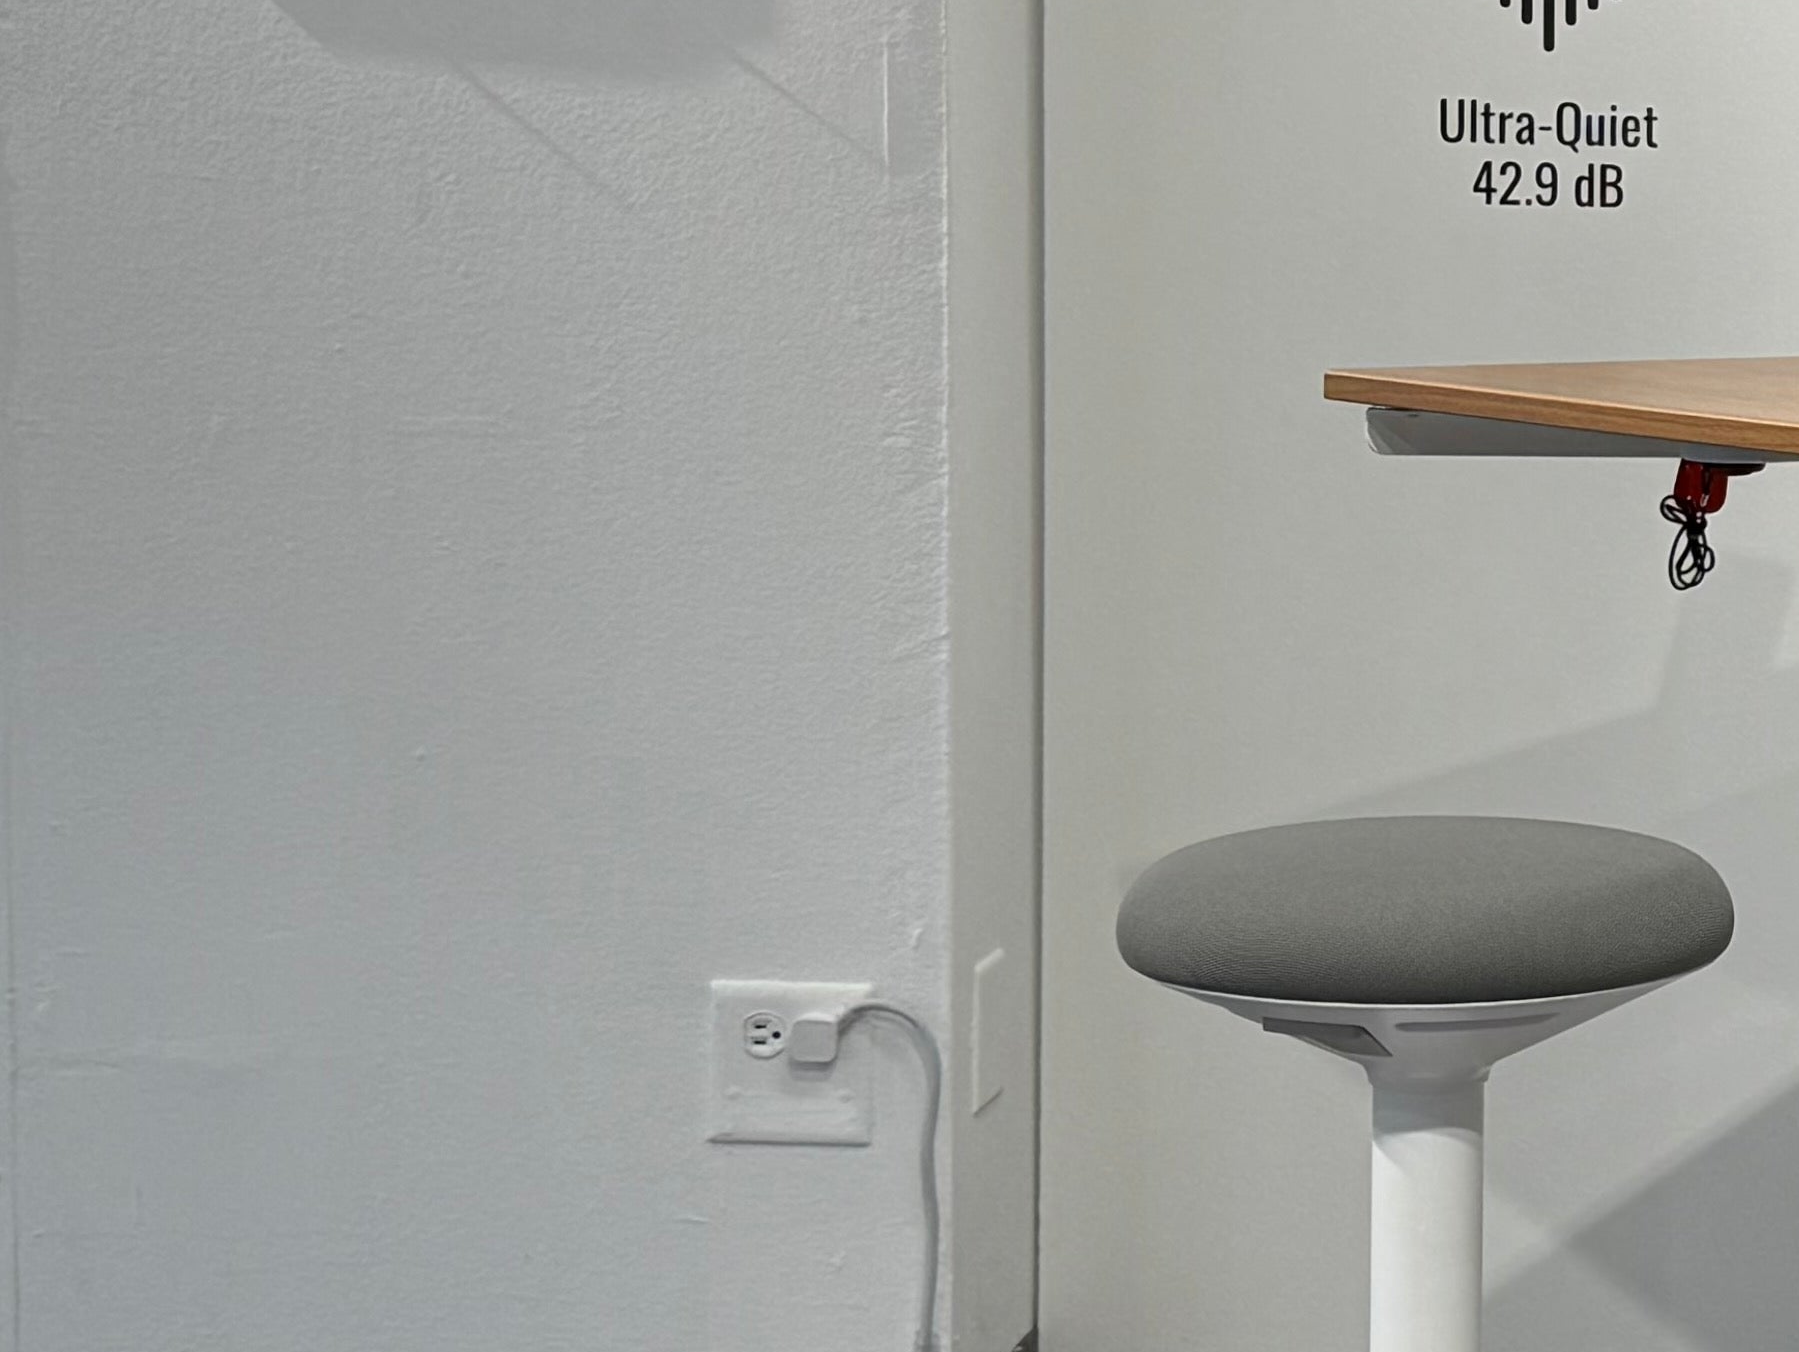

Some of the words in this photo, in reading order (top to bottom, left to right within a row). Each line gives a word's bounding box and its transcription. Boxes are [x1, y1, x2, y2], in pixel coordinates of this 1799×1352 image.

[1440, 98, 1658, 154] Ultra-Quiet
[1472, 160, 1558, 207] 42.9
[1574, 163, 1624, 208] dB
